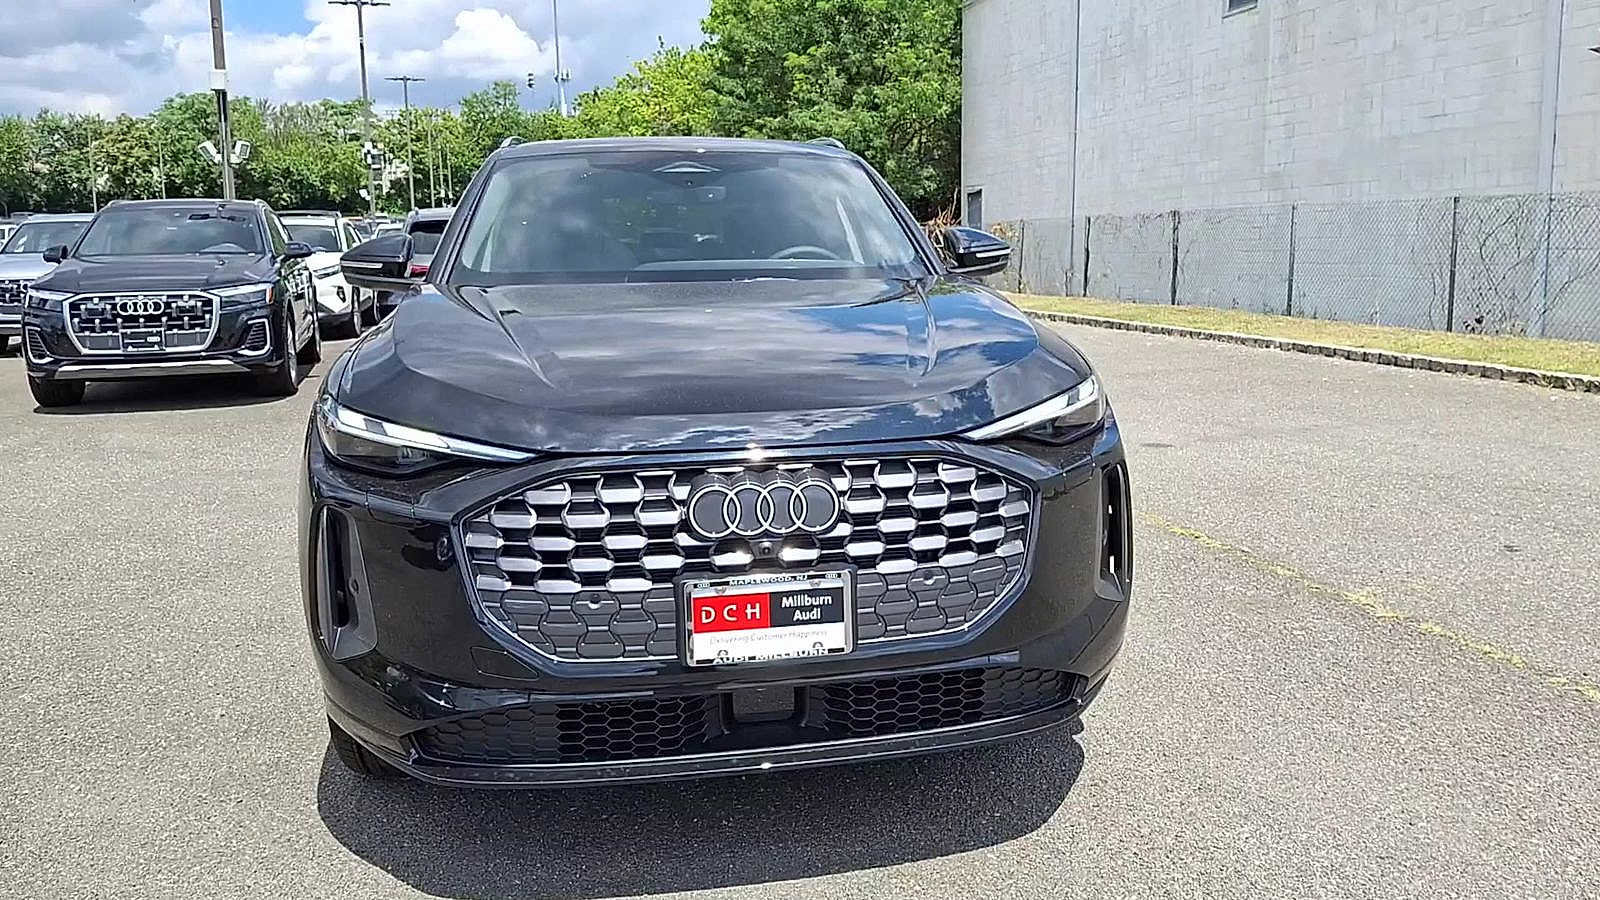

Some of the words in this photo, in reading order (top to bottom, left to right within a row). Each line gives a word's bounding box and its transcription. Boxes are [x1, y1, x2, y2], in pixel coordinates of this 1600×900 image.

[781, 594, 832, 608] Millburn
[701, 603, 761, 624] DCH
[793, 608, 821, 621] Audi
